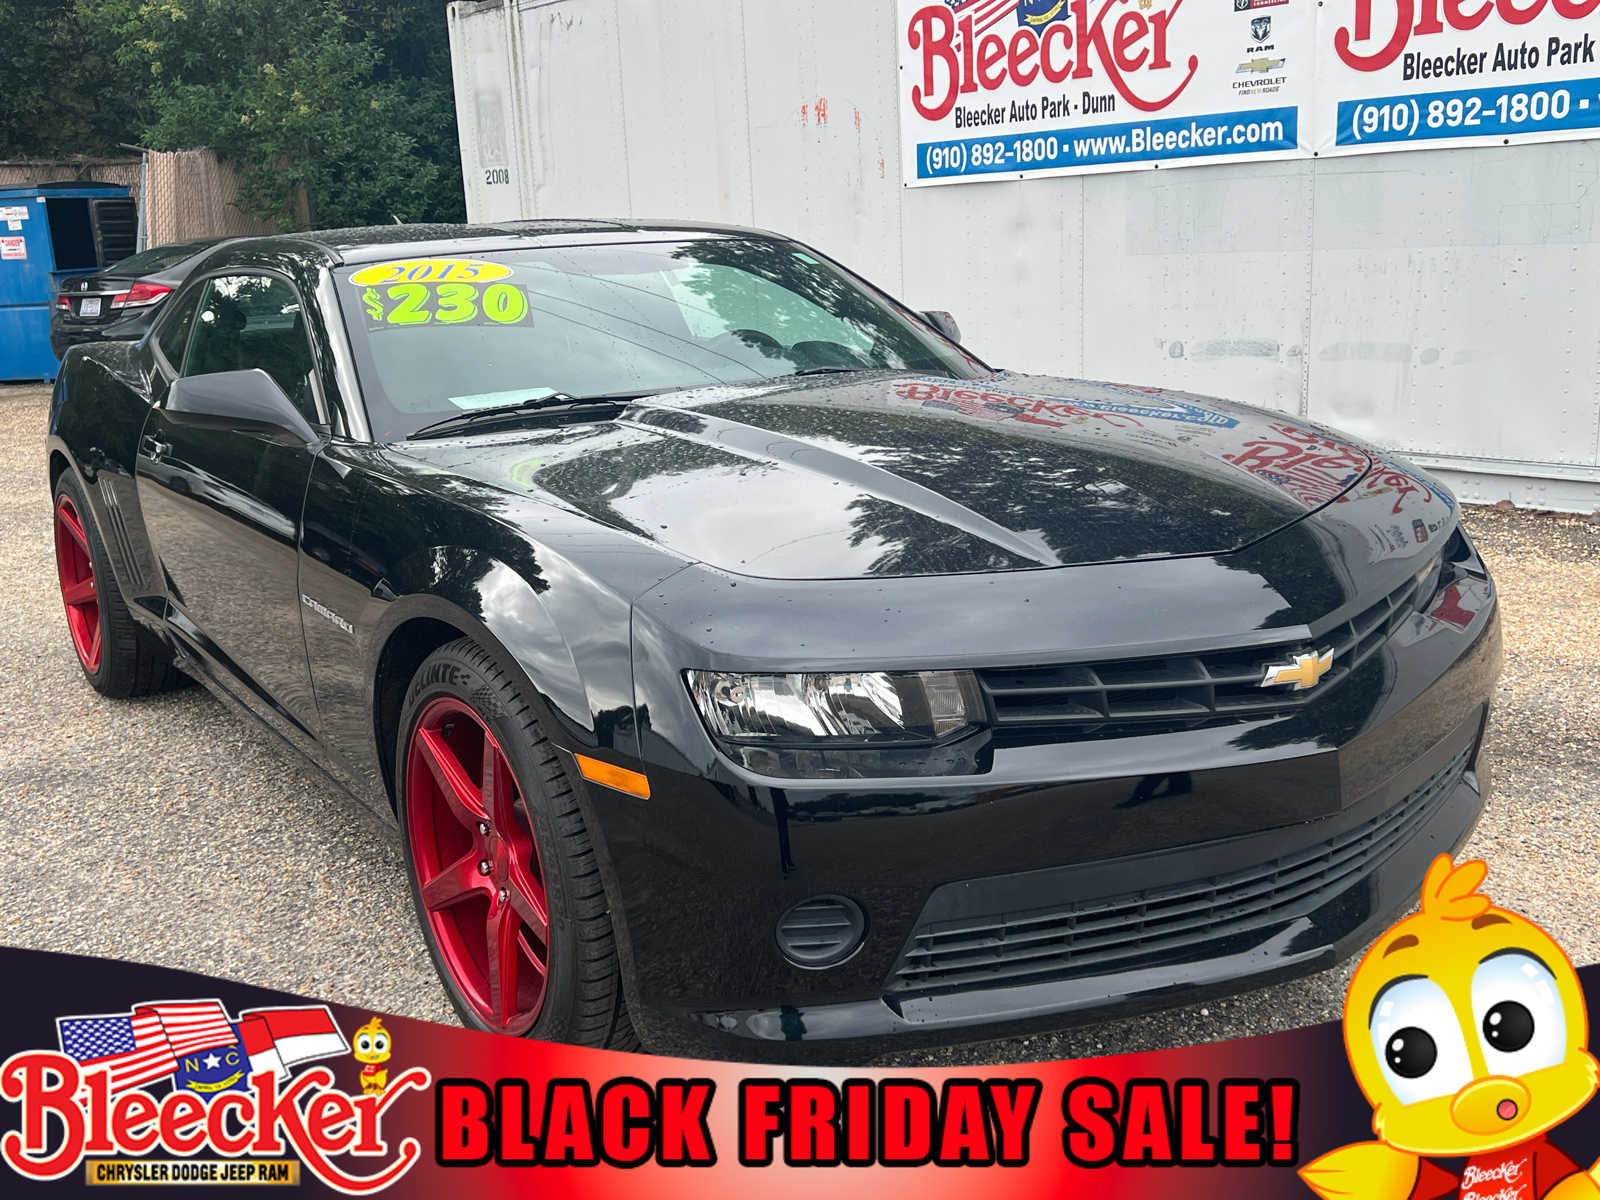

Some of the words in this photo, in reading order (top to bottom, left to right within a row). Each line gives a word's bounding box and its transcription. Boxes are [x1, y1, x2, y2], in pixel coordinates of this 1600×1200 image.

[907, 0, 1199, 121] Bleecker
[1246, 45, 1275, 53] RAM
[1403, 48, 1487, 81] Bleecker
[1492, 41, 1540, 72] Auto
[1547, 33, 1595, 66] Park
[1232, 77, 1287, 88] CHEVROLET
[955, 103, 1006, 128] Bleecker
[1009, 99, 1037, 123] Auto
[1041, 94, 1070, 119] Park
[1082, 91, 1115, 115] Dunn
[1352, 99, 1420, 139] (910)
[1427, 89, 1570, 128] 892-1800
[926, 142, 967, 174] (910)
[971, 136, 1058, 167] 892-1800
[1074, 120, 1284, 157] www.Bleecker.com
[485, 168, 510, 184] 2008
[381, 264, 484, 283] 2015
[362, 283, 528, 326] $230
